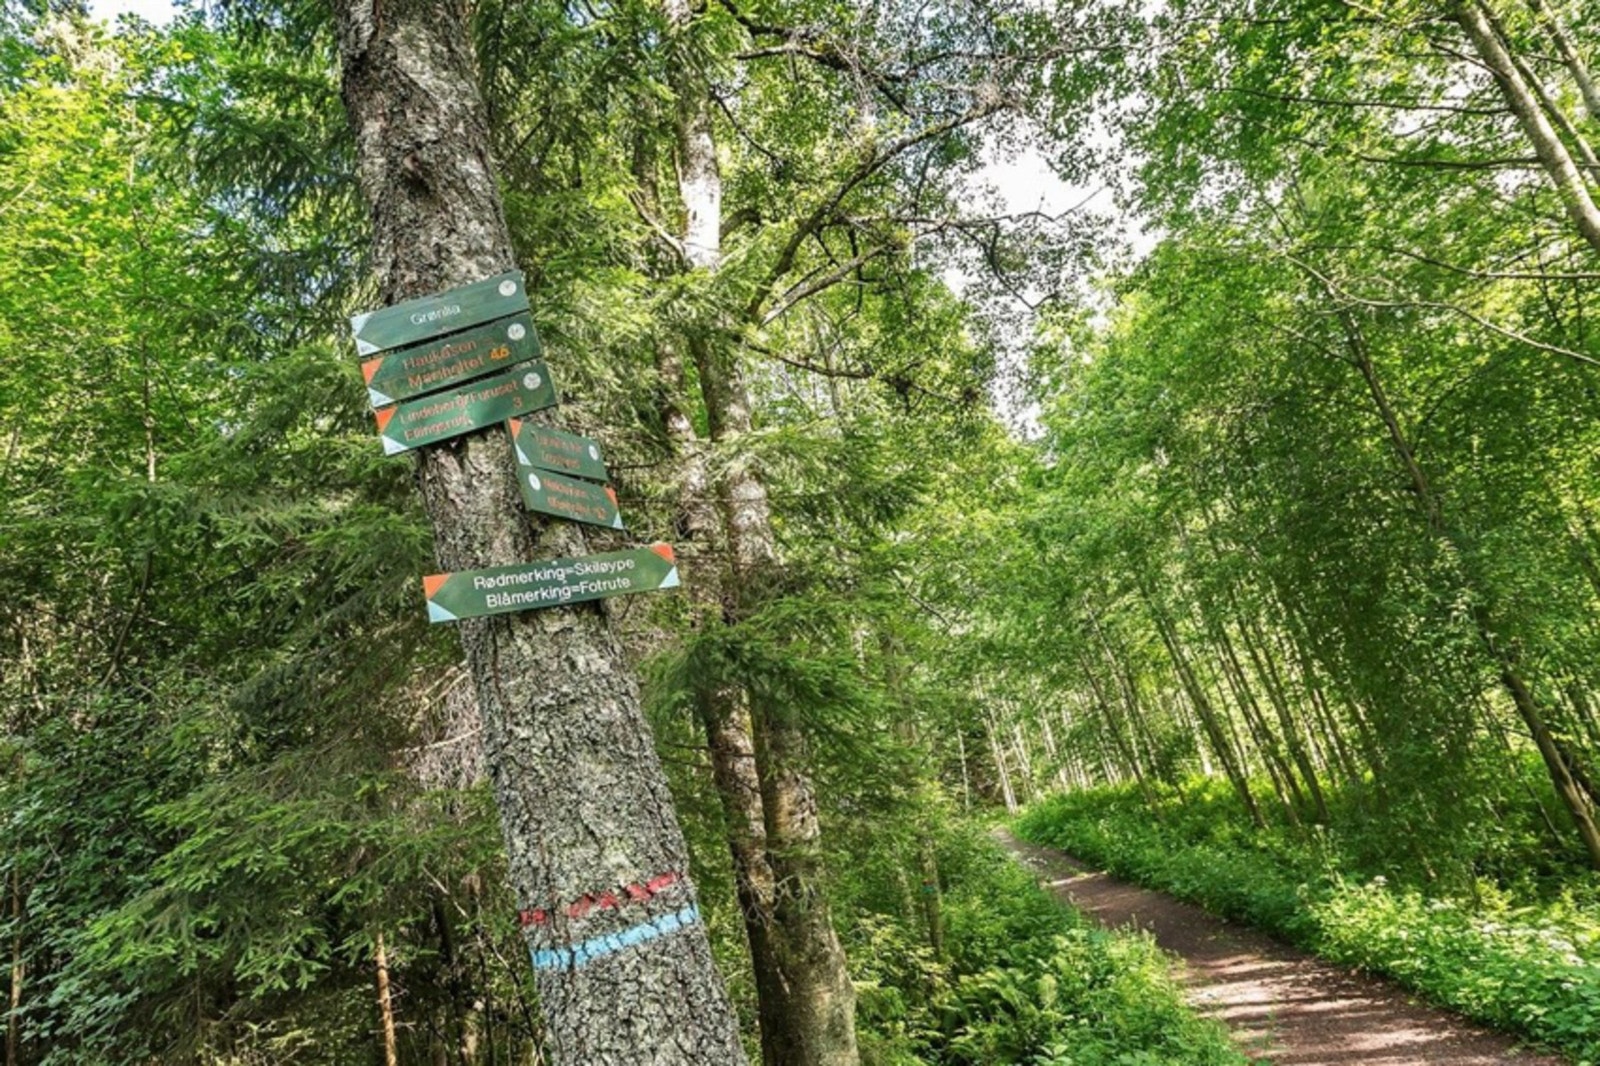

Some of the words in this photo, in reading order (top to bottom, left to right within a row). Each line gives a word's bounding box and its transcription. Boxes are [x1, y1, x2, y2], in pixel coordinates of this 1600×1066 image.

[410, 304, 461, 325] Grønlia
[474, 558, 635, 590] Rødmerking=Skiløype
[486, 577, 632, 608] Blåmerking=Fotrute
